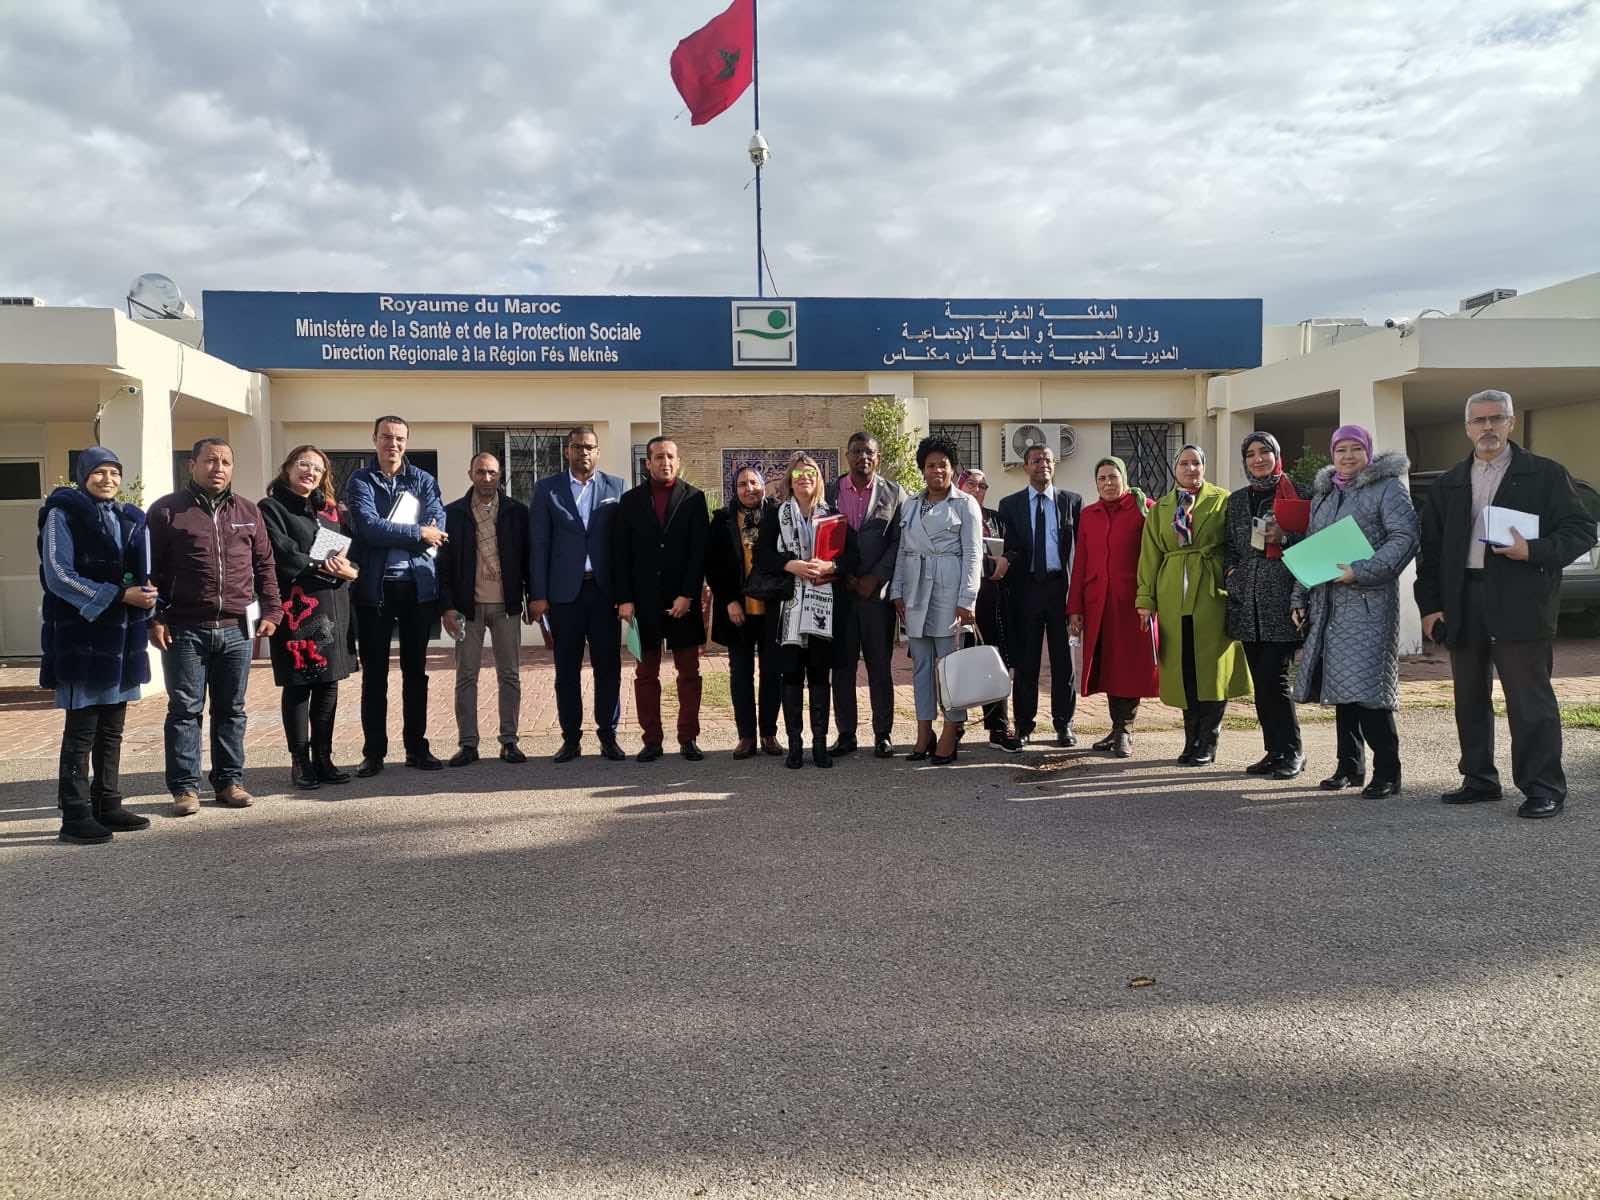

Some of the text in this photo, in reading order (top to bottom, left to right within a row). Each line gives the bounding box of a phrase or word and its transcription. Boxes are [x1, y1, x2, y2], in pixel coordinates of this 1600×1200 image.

[379, 296, 561, 315] Royaume du Maroc
[945, 301, 1118, 323] المملكة المغربية
[370, 321, 387, 338] de
[392, 320, 405, 338] la
[456, 322, 470, 339] et
[474, 322, 491, 339] de
[495, 322, 508, 339] la
[513, 322, 585, 341] Protection
[590, 323, 641, 341] Sociale
[978, 323, 1030, 343] الحماية
[1035, 331, 1044, 343] و
[1047, 322, 1123, 340] الصحة
[1127, 325, 1160, 343] وزارة
[322, 344, 384, 361] Direction
[390, 345, 458, 365] Régionale
[461, 345, 471, 362] à
[474, 346, 486, 362] la
[490, 345, 536, 366] Région
[883, 345, 950, 365] مكناس
[956, 343, 997, 365] فاس
[1048, 343, 1105, 365] الجهوية
[1111, 343, 1179, 364] المديرية
